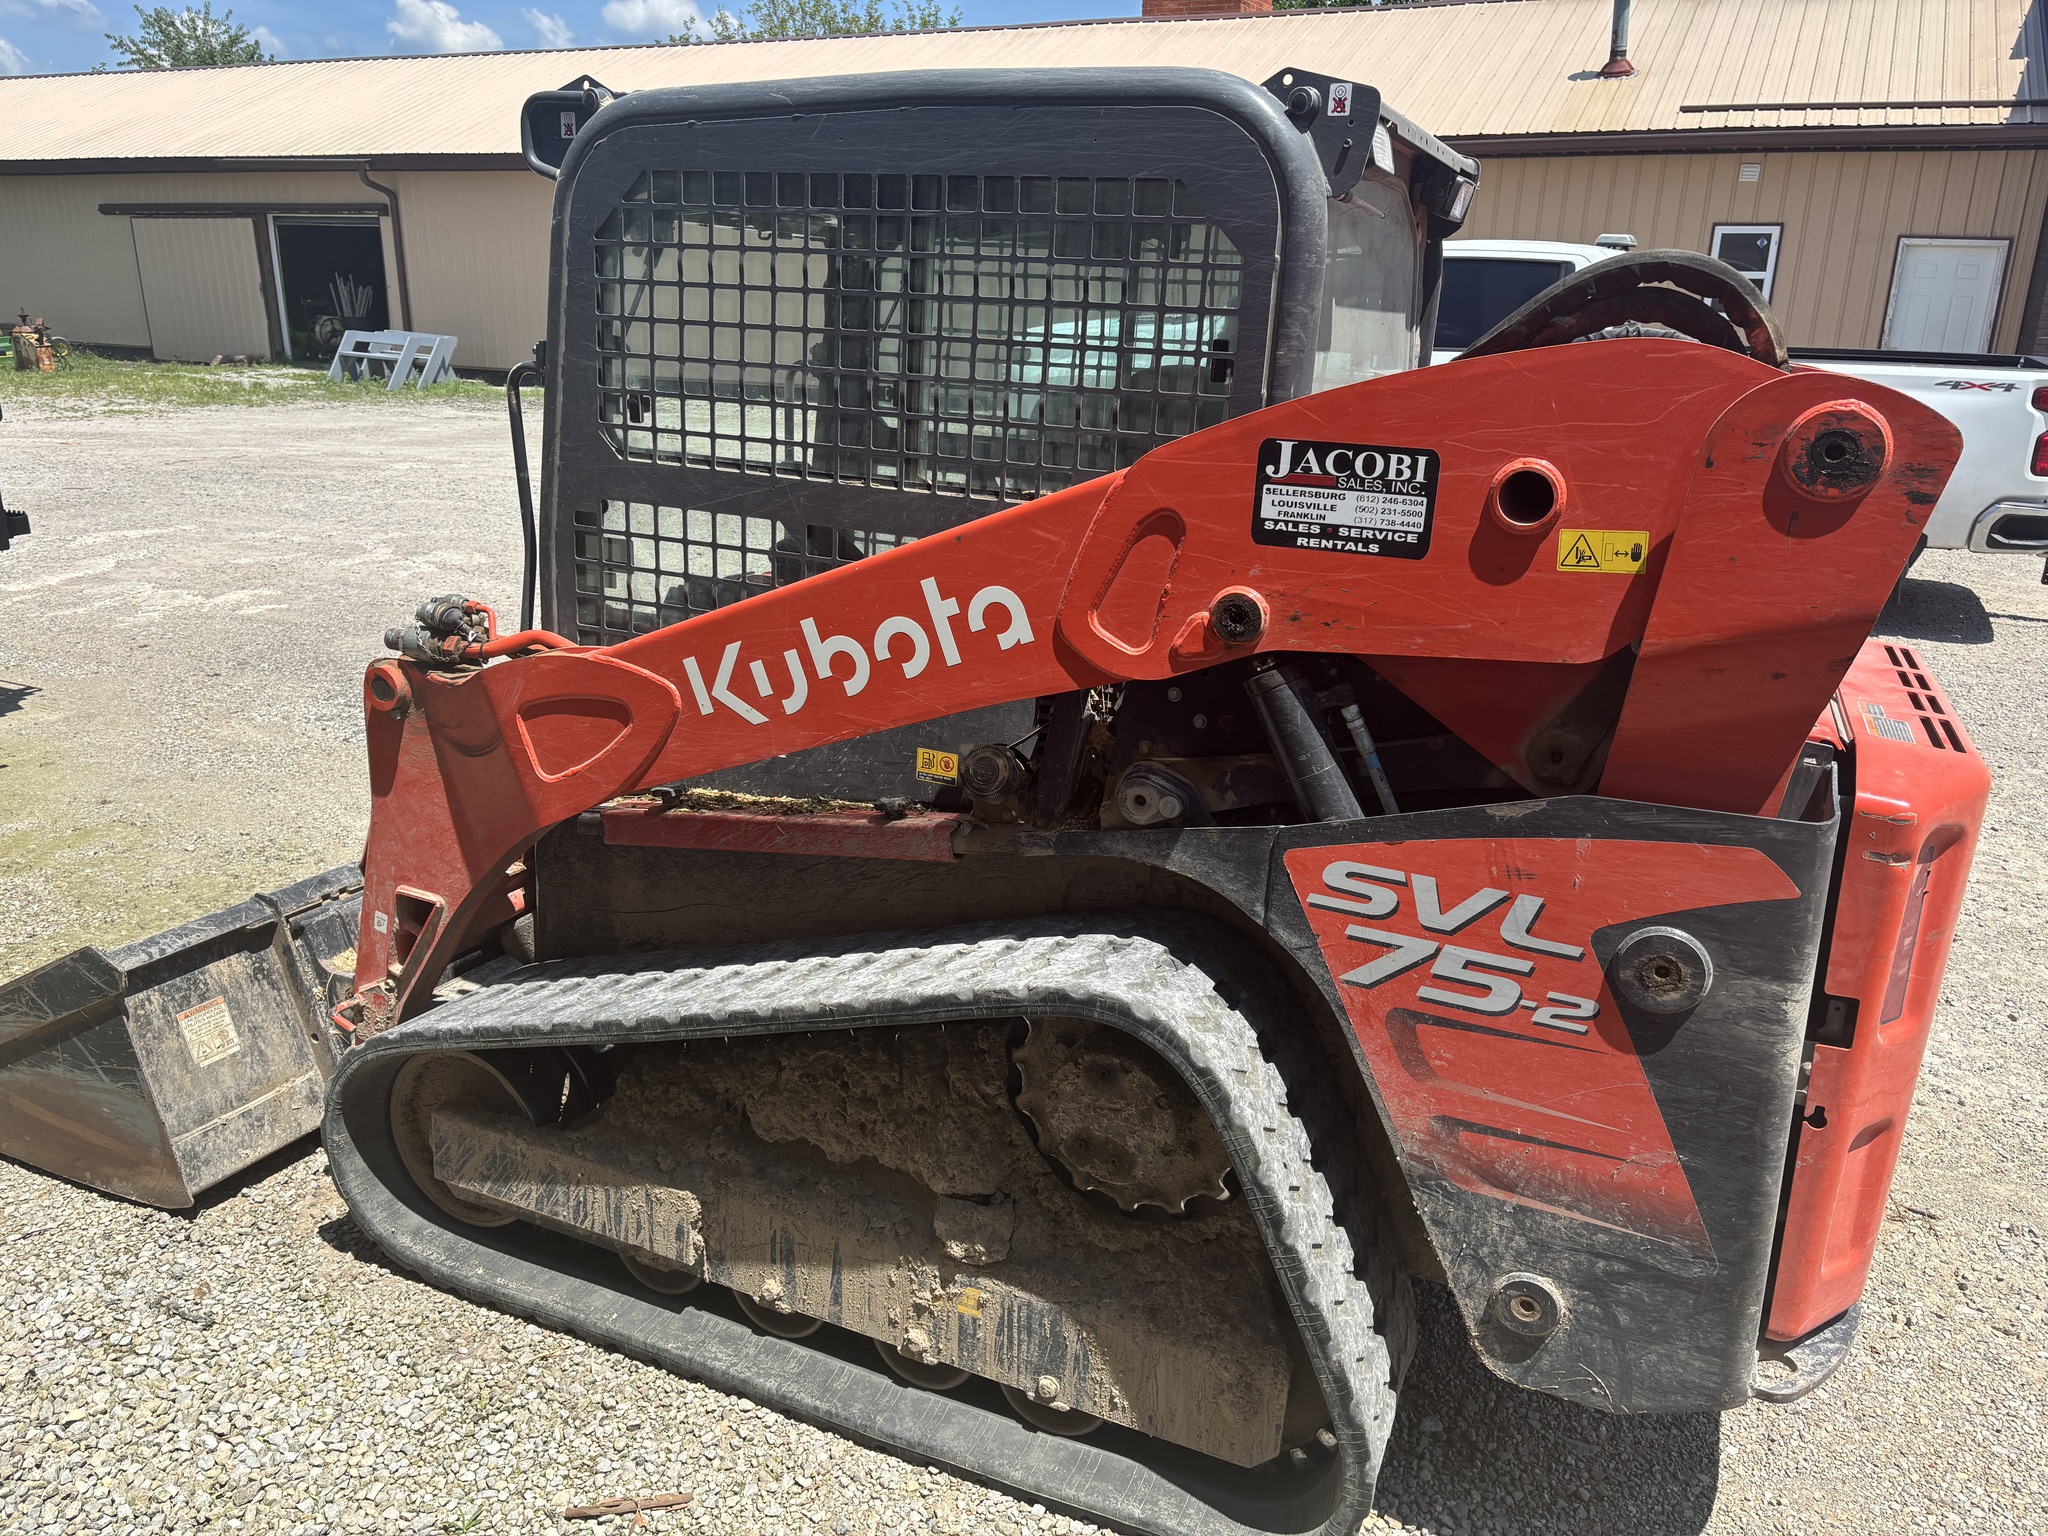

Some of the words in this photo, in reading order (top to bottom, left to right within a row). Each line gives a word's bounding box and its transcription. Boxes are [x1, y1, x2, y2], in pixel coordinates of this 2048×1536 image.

[1265, 440, 1430, 483] JACOBI
[1337, 476, 1386, 494] SALES,
[1391, 481, 1426, 495] INC.
[1265, 487, 1346, 501] SELLERSBURG
[1356, 494, 1380, 504] (812)
[1382, 496, 1425, 507] 246-6304
[1271, 499, 1337, 512] LOUISVILLE
[1355, 505, 1379, 516] (502)
[1380, 507, 1423, 518] 231-5500
[1277, 510, 1326, 522] FRANKLIN
[1354, 516, 1378, 527] (317)
[1380, 518, 1422, 530] 738-4440
[1264, 520, 1321, 534] SALES
[1338, 527, 1418, 543] SERVICE
[1296, 538, 1380, 553] RENTALS
[682, 576, 1035, 725] Kubota
[1306, 860, 1586, 962] SVL
[1338, 923, 1600, 1036] 75-2
[184, 1005, 223, 1025] UNDERGROUND
[189, 1000, 219, 1016] WARNING
[207, 1008, 226, 1021] HAZARD
